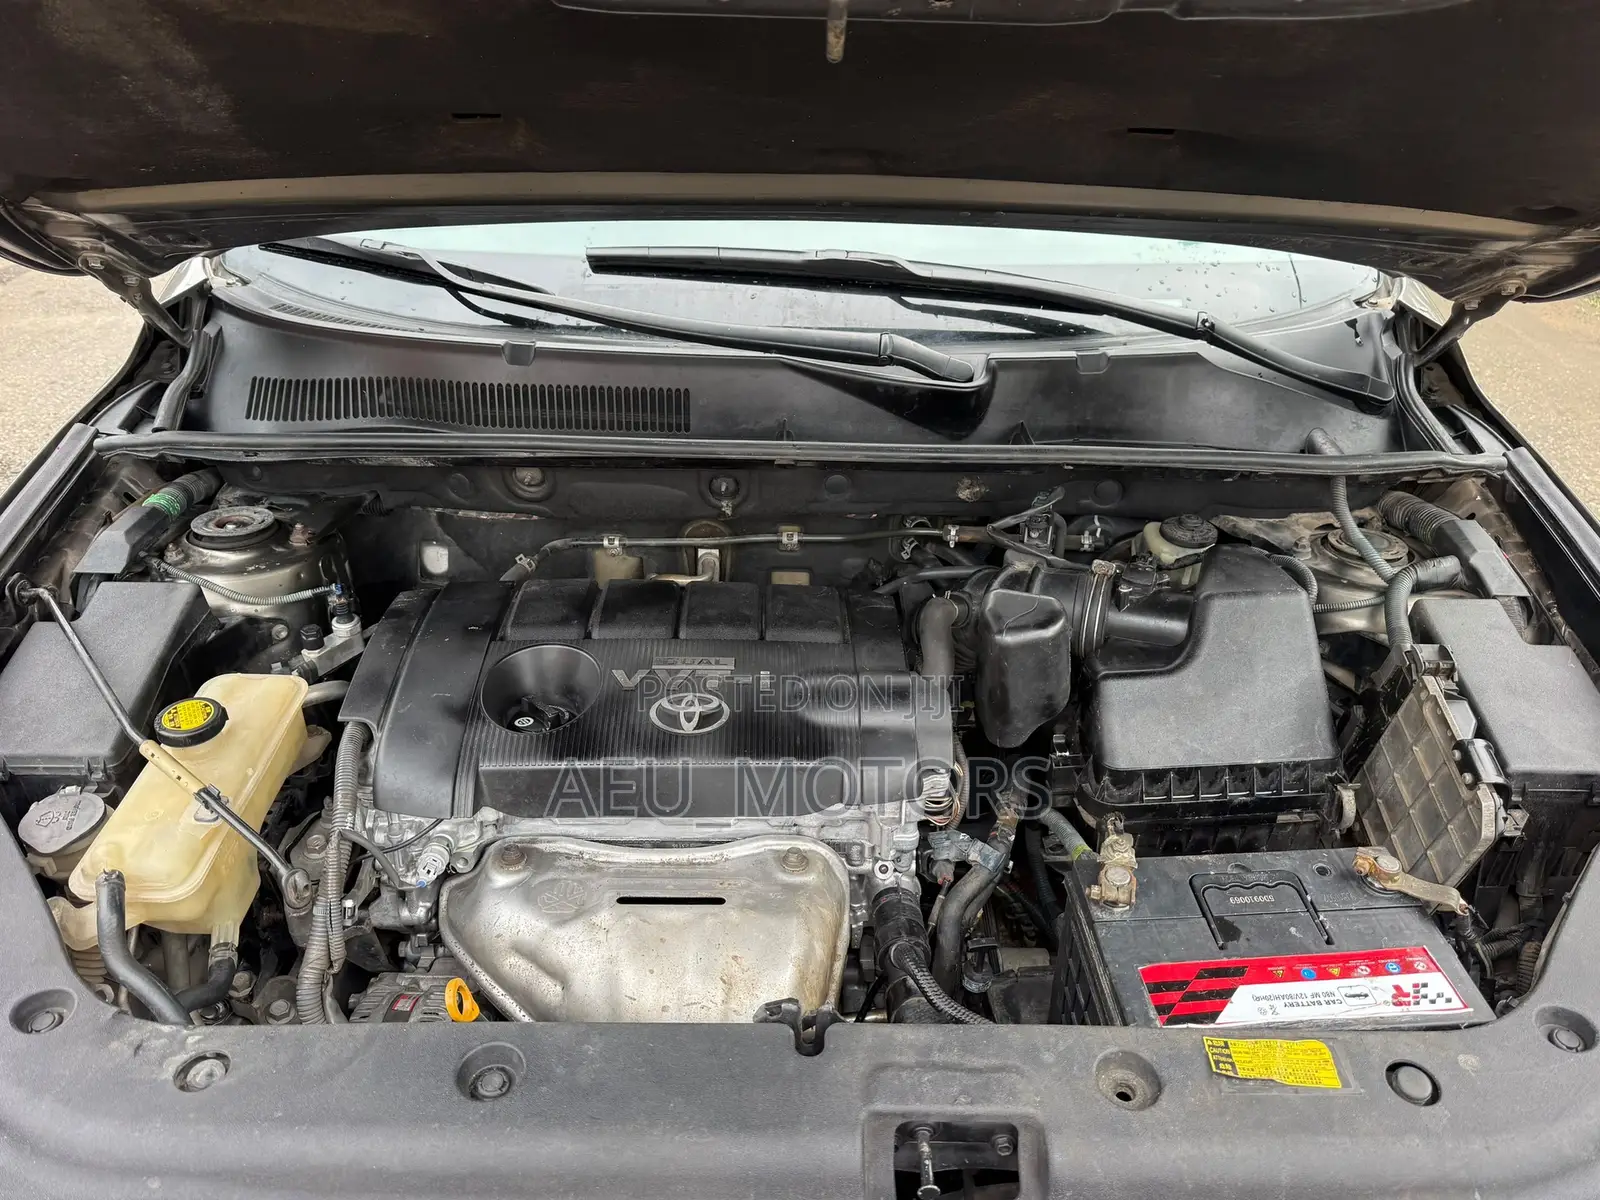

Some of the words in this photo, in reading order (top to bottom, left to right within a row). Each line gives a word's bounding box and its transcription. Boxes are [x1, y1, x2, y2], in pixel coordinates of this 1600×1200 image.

[665, 656, 729, 666] DUAL
[1321, 990, 1336, 998] N80
[1283, 999, 1322, 1008] BATTERY
[1325, 998, 1343, 1006] CAR
